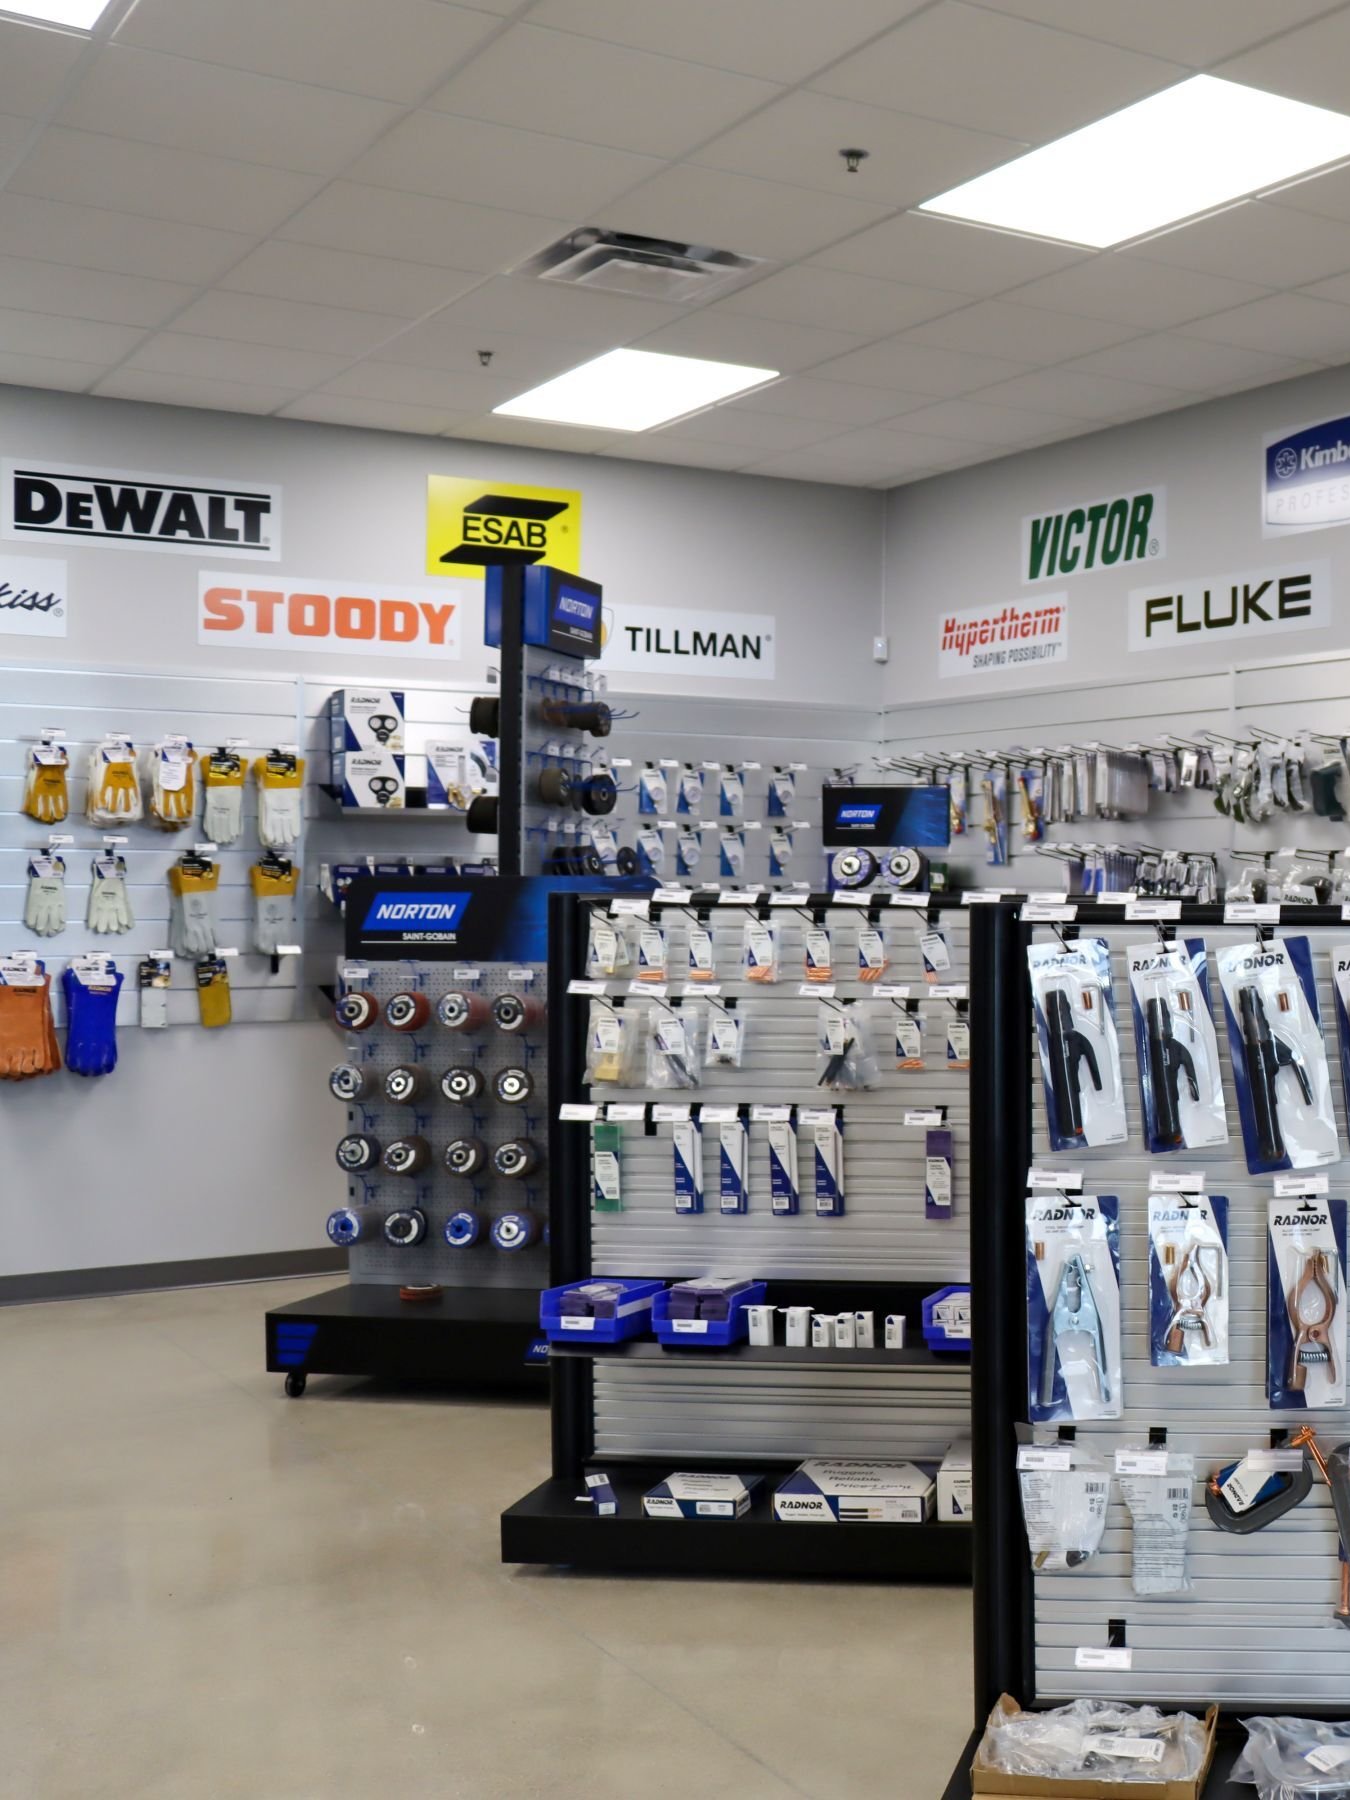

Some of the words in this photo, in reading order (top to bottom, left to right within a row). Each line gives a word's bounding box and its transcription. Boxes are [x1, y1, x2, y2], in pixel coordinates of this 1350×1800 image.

[463, 516, 547, 549] ESAB
[1029, 493, 1154, 580] VICTOR
[204, 587, 456, 644] STOODY
[1146, 574, 1312, 637] FLUKE
[625, 626, 761, 660] TILLMAN
[942, 607, 1061, 656] Hypertherm
[972, 650, 1007, 668] SHAPING
[1008, 643, 1056, 662] POSSIBILITY
[840, 810, 875, 818] NORTON
[377, 904, 456, 919] NORTON
[402, 932, 456, 941] SAINT-GOBAIN
[1274, 1214, 1328, 1226] RADNOR
[780, 1500, 823, 1510] RADNOR
